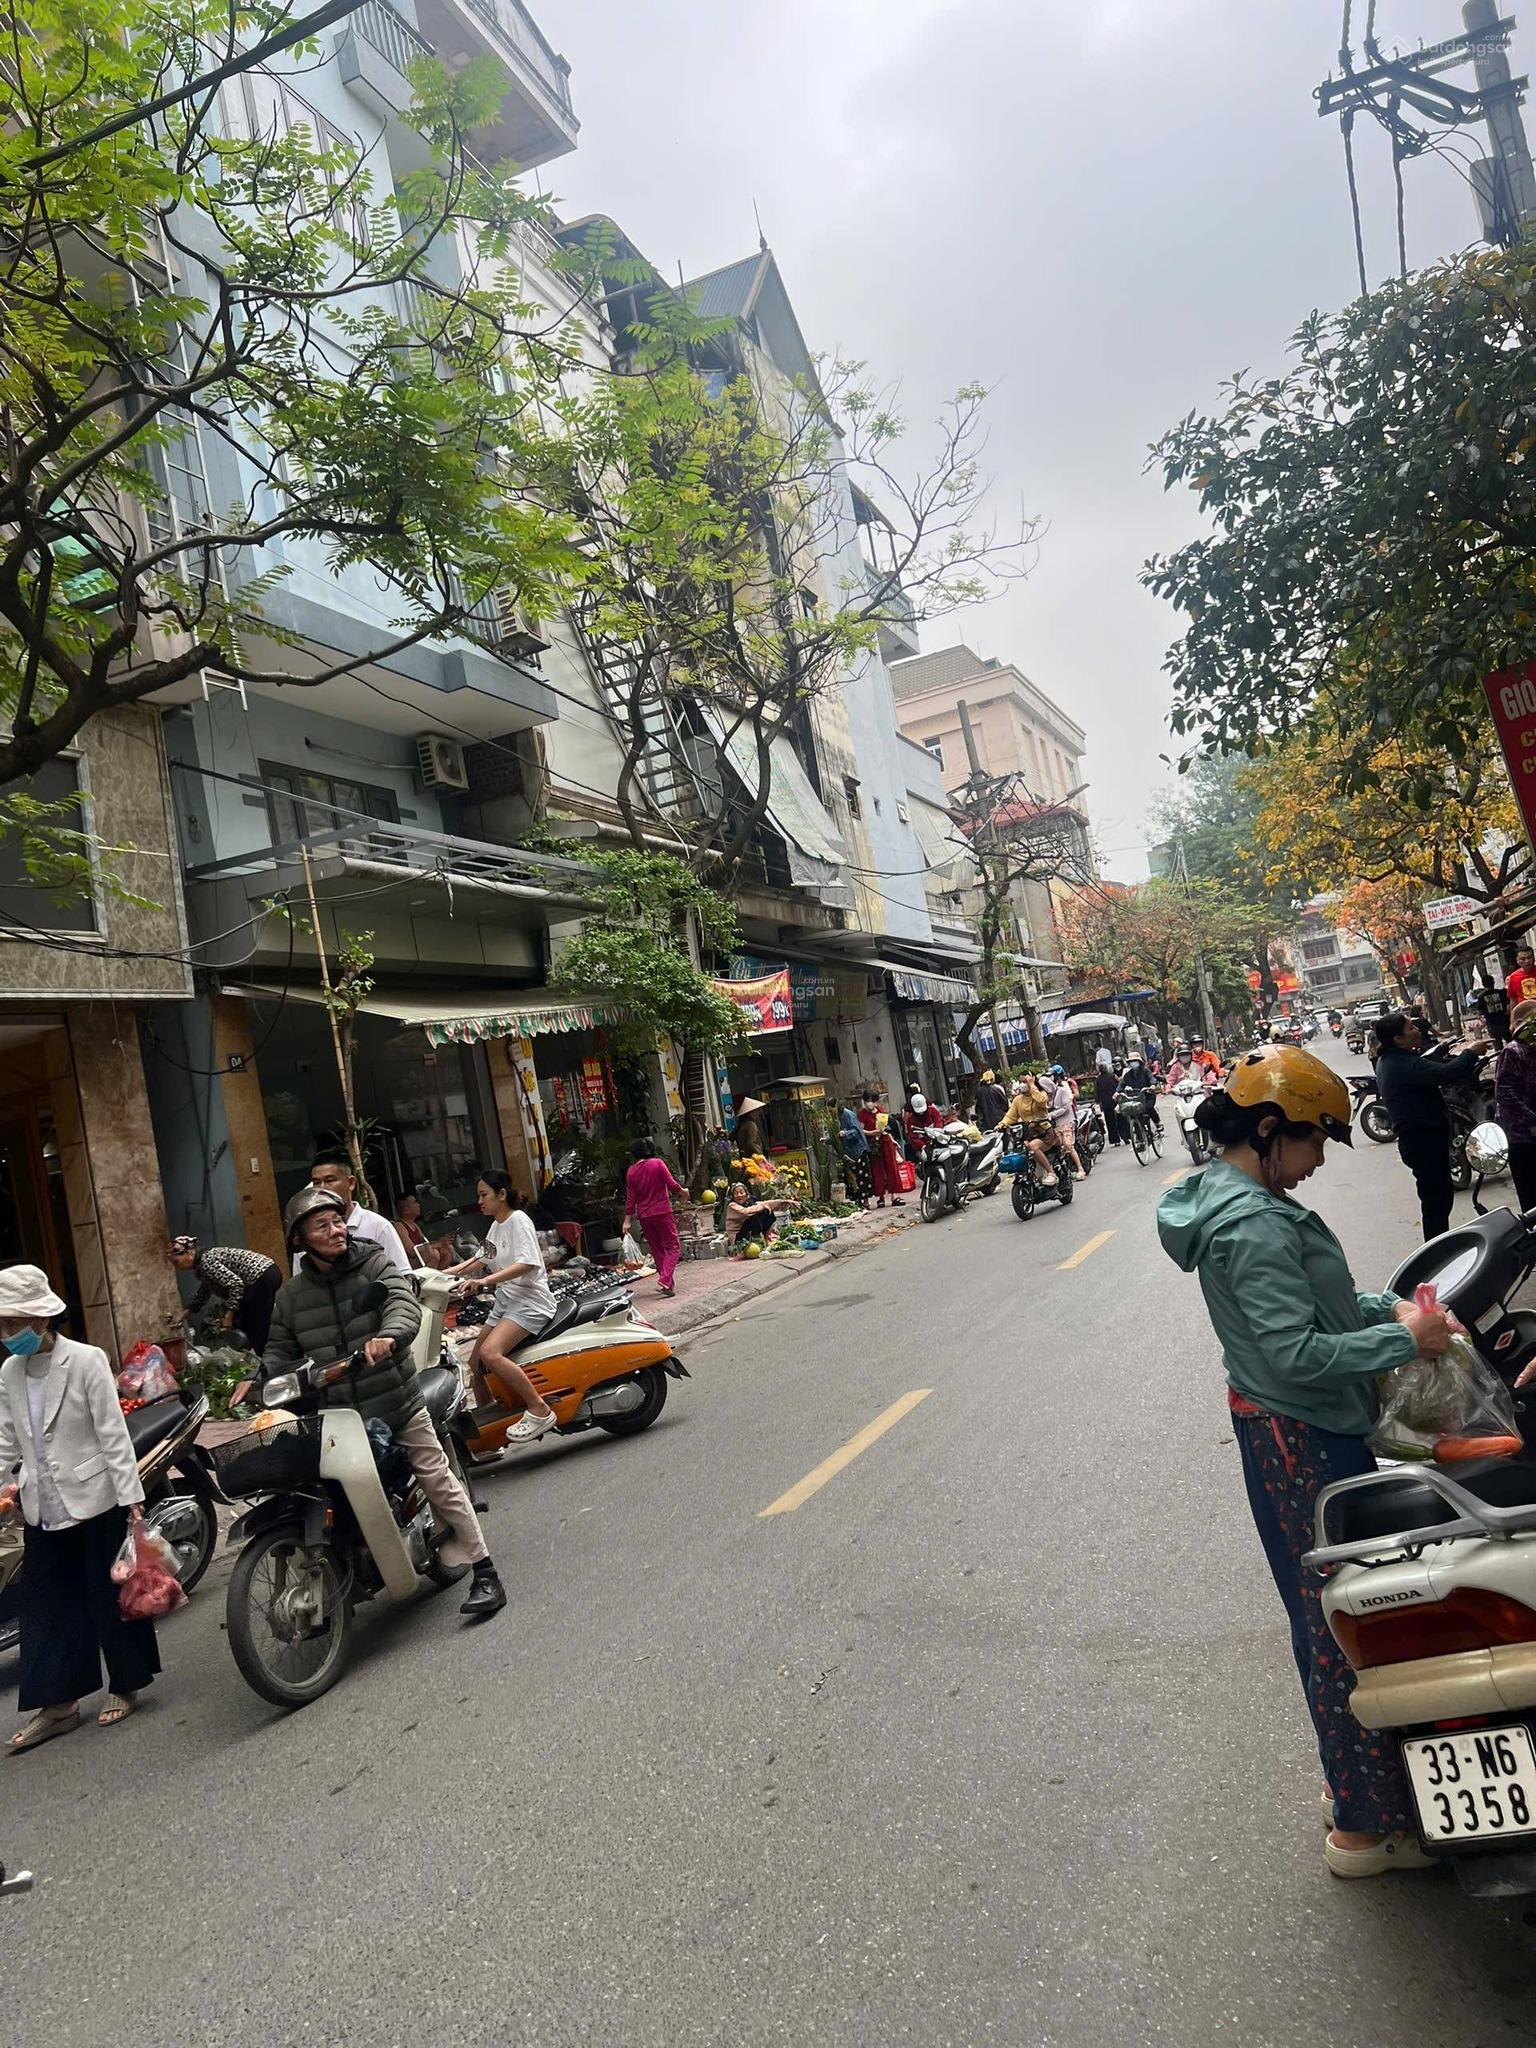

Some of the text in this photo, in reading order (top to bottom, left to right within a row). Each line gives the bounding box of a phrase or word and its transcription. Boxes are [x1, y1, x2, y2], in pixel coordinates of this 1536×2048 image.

[1359, 1589, 1424, 1608] HONDA
[1421, 1734, 1518, 1786] 33-N6
[1433, 1783, 1530, 1835] 3358
